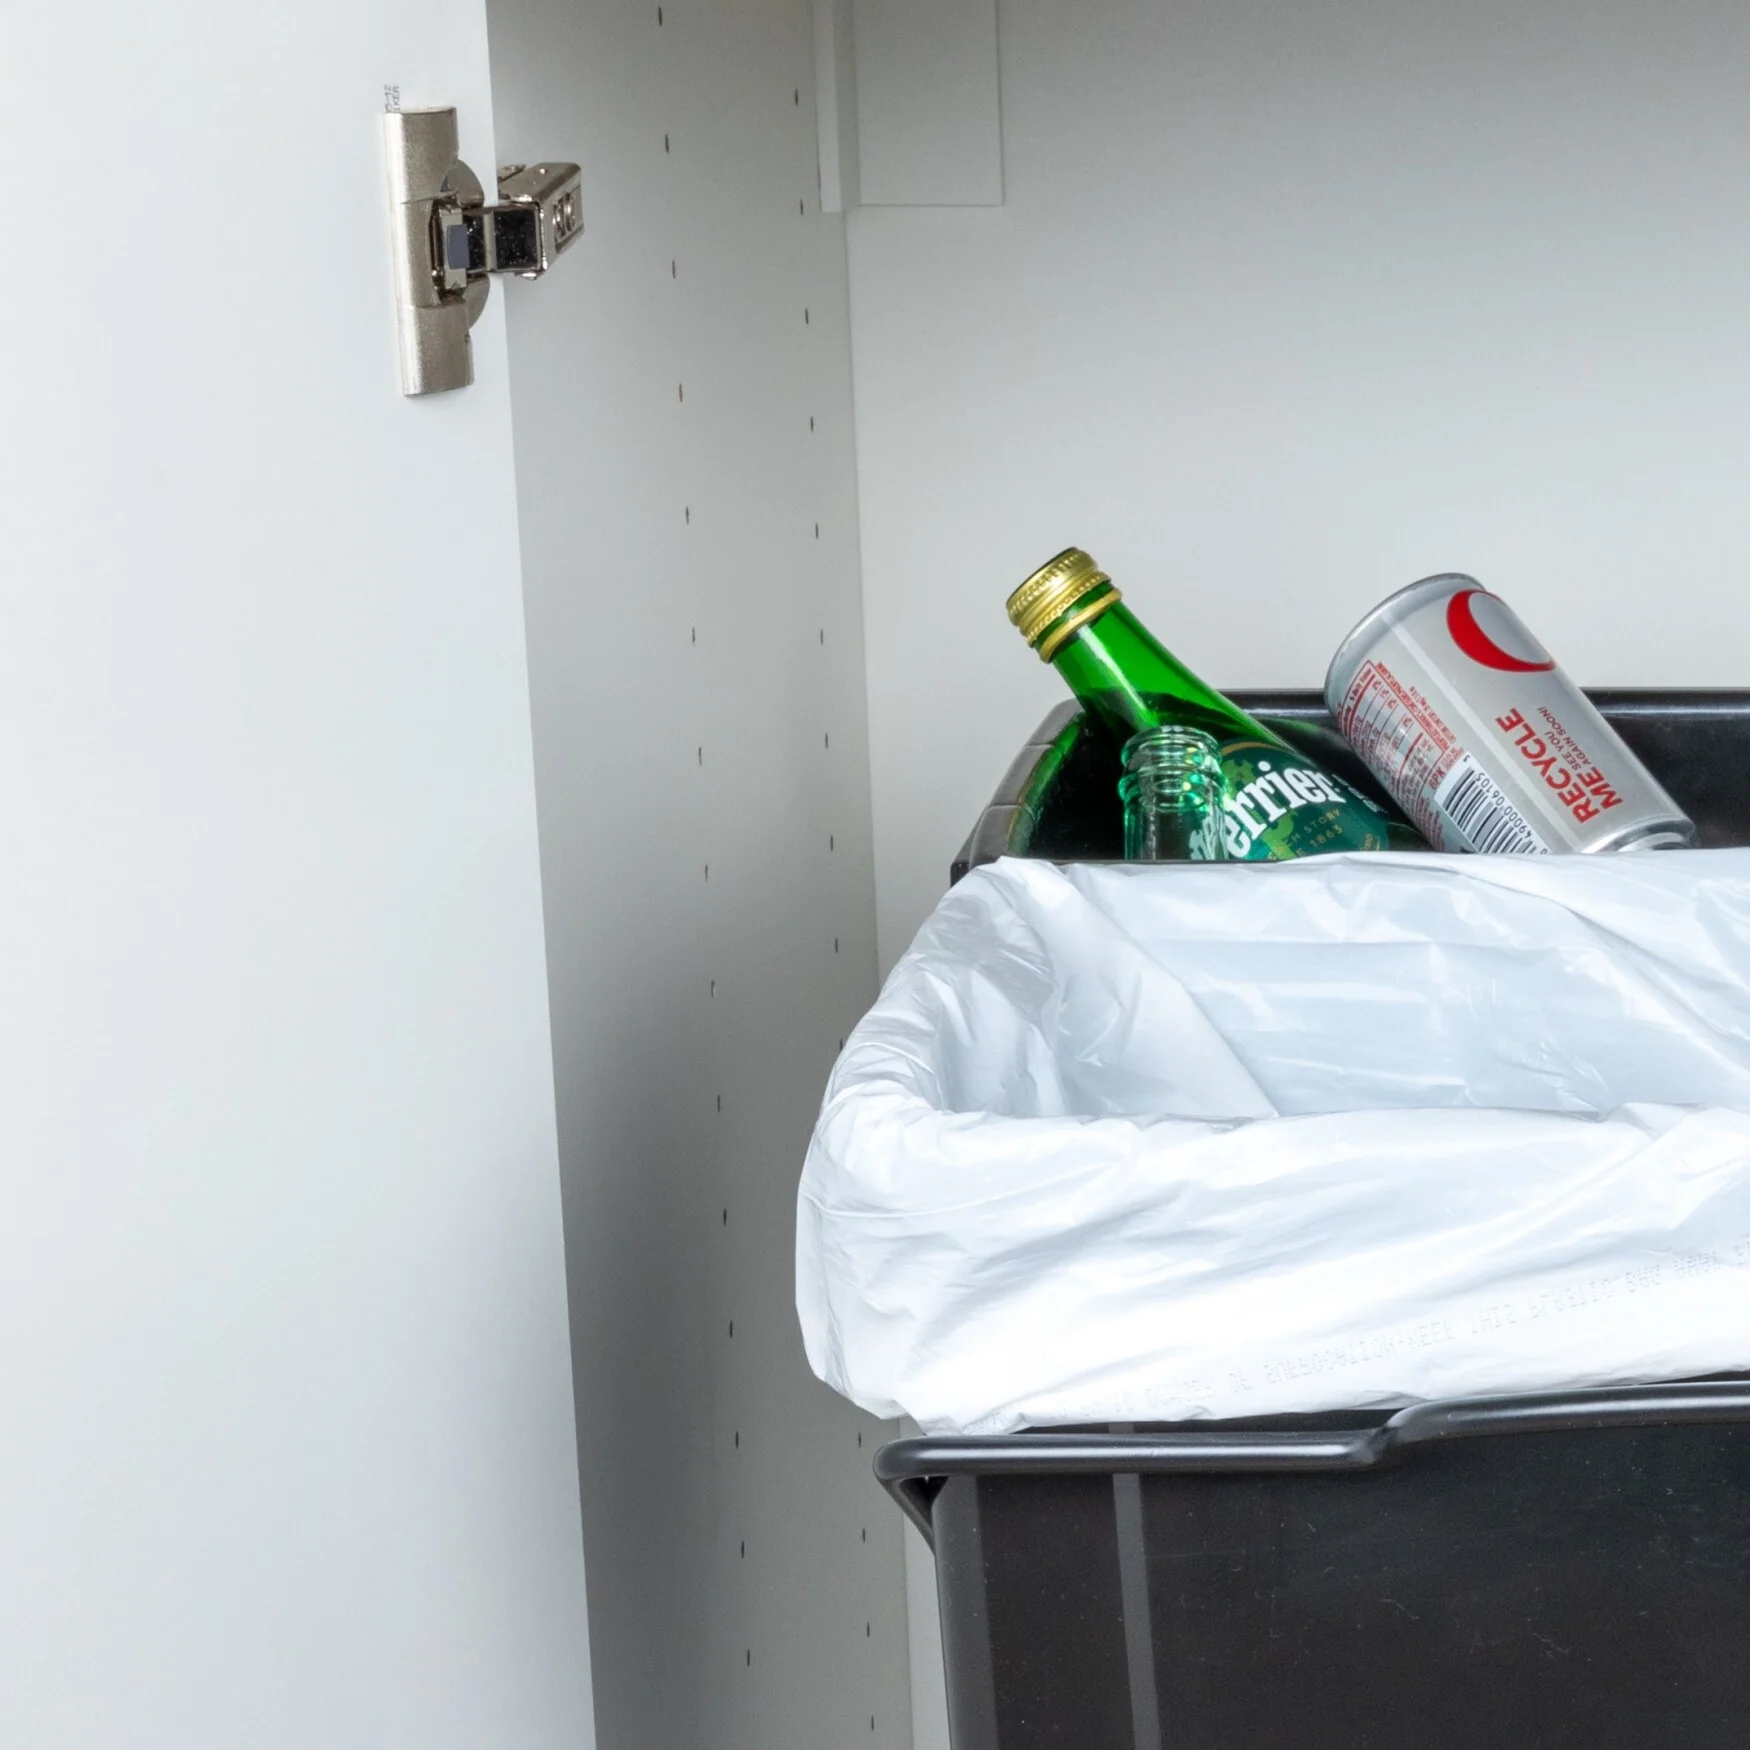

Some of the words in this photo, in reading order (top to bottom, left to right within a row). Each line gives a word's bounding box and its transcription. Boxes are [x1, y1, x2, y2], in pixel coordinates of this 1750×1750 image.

[1536, 705, 1567, 736] SOON!
[1543, 730, 1565, 751] YOU
[1562, 735, 1591, 766] AGAIN
[1496, 709, 1600, 823] RECYCLE
[1561, 751, 1582, 772] SEE
[1429, 767, 1446, 789] 6PK
[1475, 773, 1505, 805] 06105
[1577, 766, 1623, 809] ME
[1304, 808, 1340, 833] STORY
[1503, 805, 1533, 838] 49000
